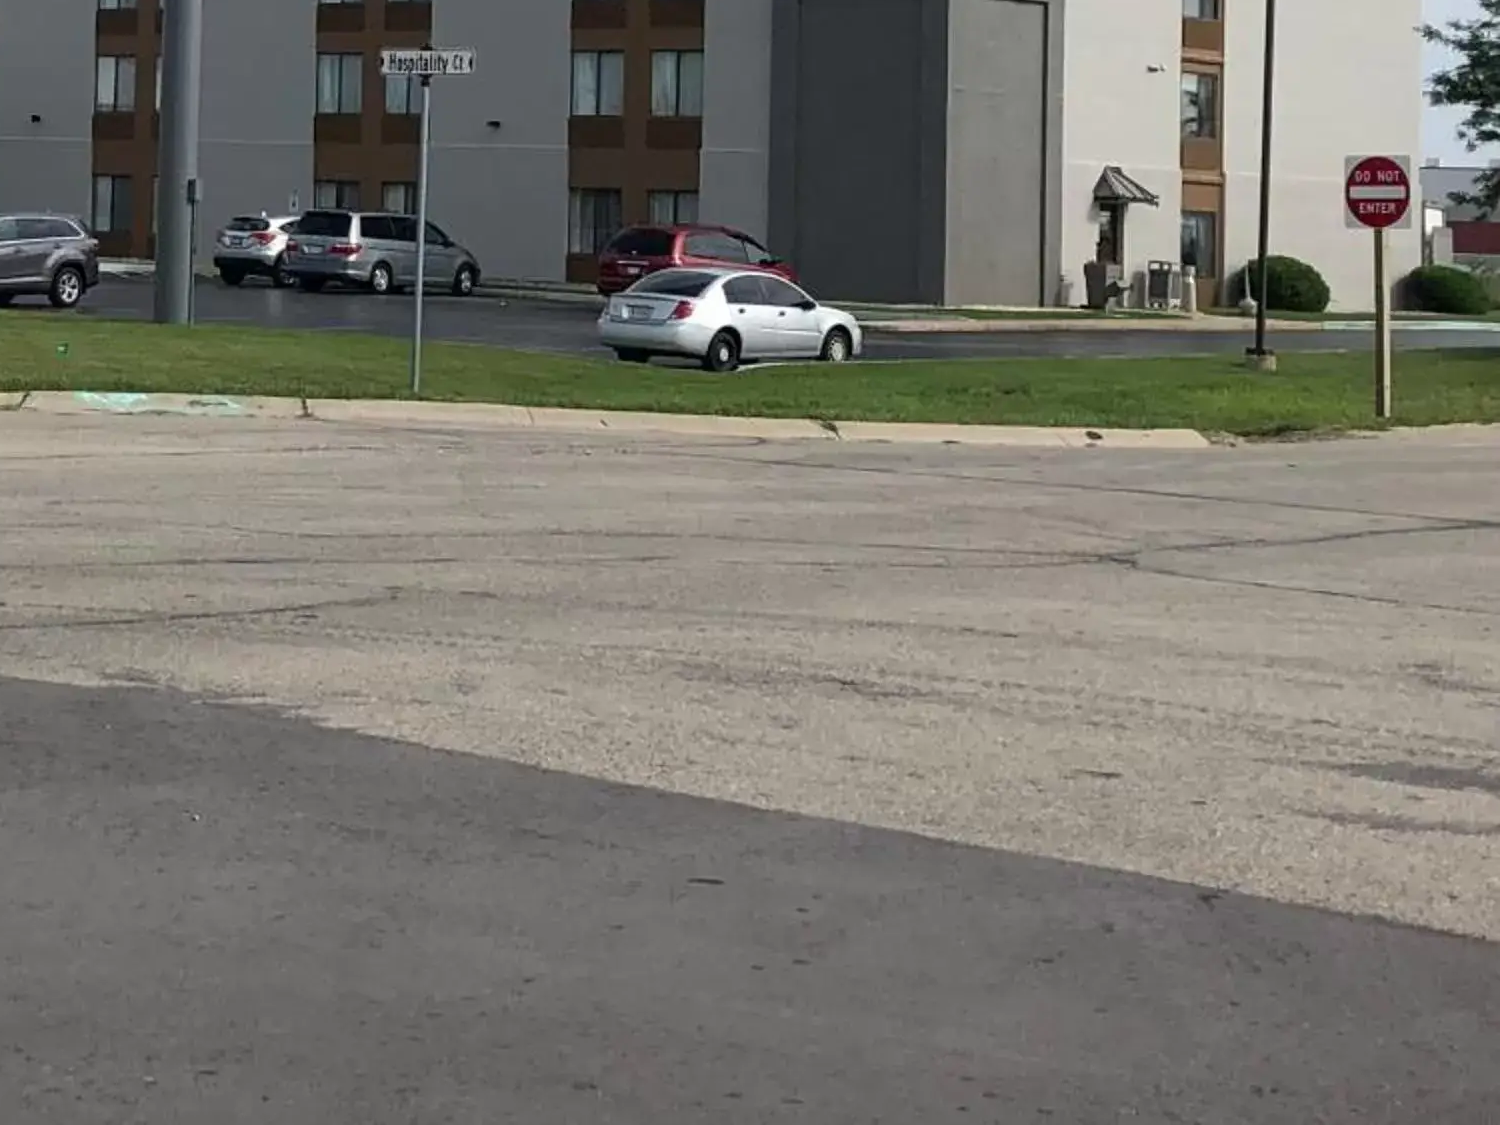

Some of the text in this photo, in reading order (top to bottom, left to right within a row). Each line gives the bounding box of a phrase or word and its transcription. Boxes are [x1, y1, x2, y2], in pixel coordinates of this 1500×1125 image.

[389, 53, 463, 73] Hospitality Ct
[1355, 170, 1400, 182] DO NOT
[1359, 202, 1396, 215] ENTER
